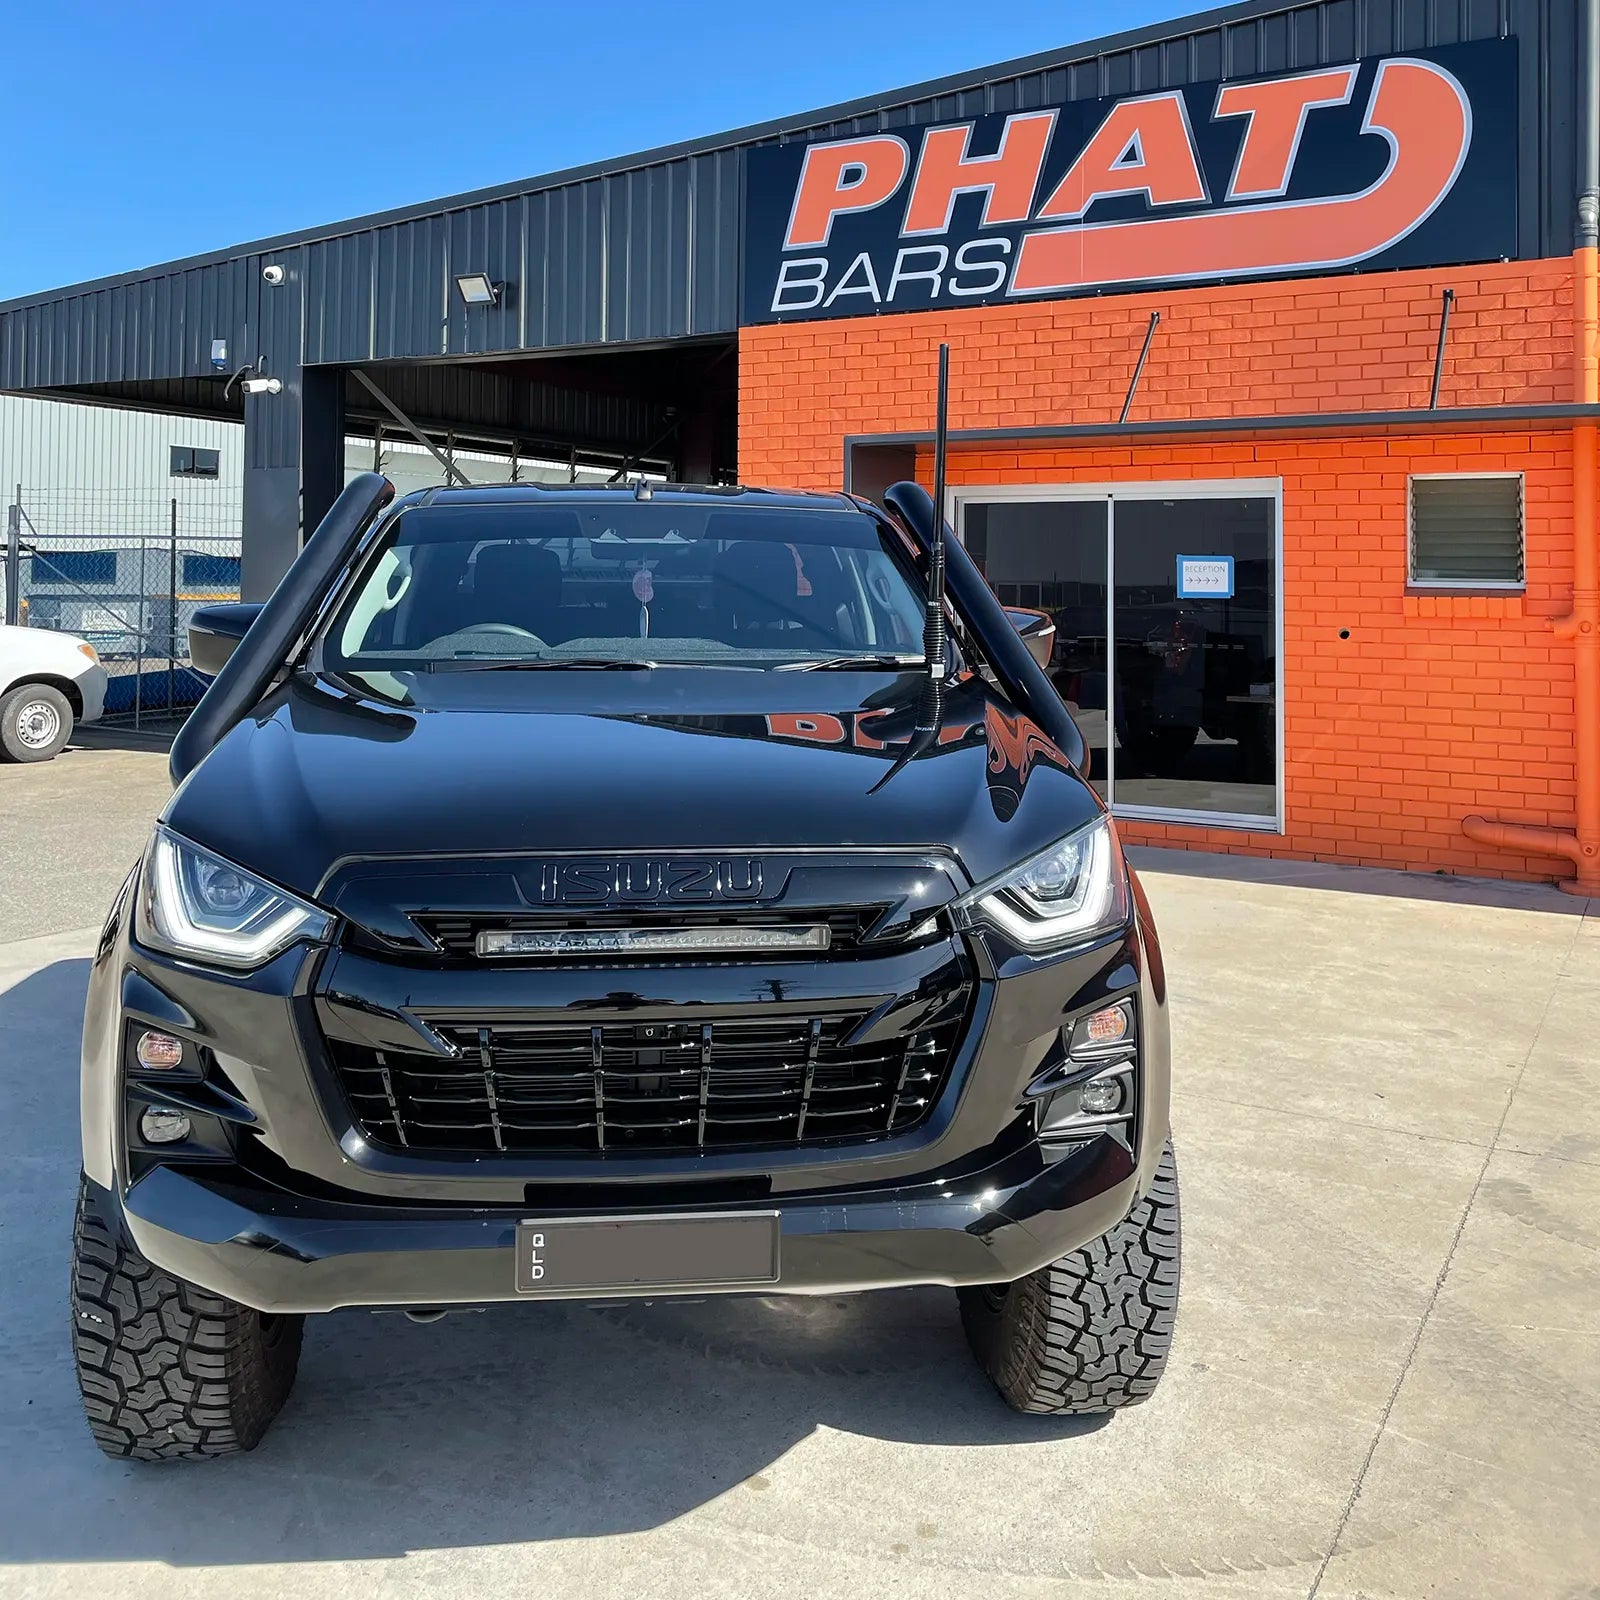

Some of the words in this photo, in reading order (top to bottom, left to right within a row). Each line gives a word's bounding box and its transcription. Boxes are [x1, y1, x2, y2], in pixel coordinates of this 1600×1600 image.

[781, 63, 1361, 251] PHAT
[771, 237, 1011, 312] BARS
[1184, 565, 1226, 574] RECEPTION
[540, 860, 764, 902] ISUZU
[531, 1233, 545, 1279] QLD
